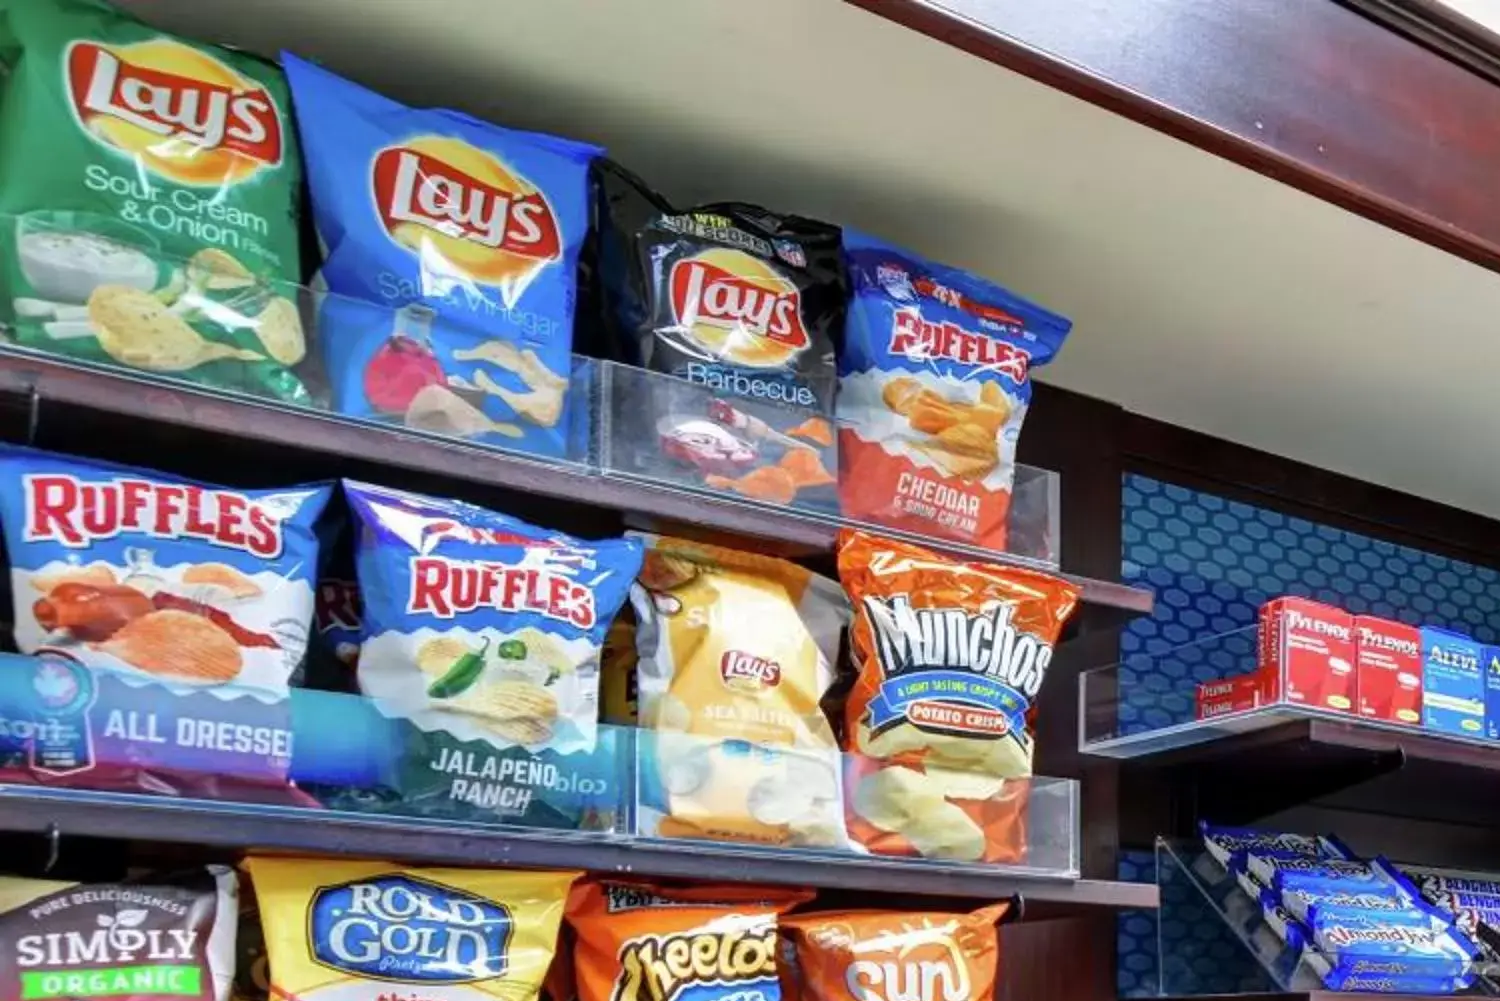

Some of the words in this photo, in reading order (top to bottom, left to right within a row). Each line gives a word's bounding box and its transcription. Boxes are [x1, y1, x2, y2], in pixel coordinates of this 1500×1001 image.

[84, 47, 268, 151] Lay's
[84, 164, 163, 202] Sour
[172, 190, 268, 236] Cream
[390, 153, 545, 249] Lay's
[377, 270, 427, 300] Sal
[683, 265, 796, 341] Lay's
[890, 310, 1030, 385] RUFFLES
[686, 361, 815, 407] Barbecue
[897, 471, 981, 517] CHEDDAR
[30, 476, 283, 557] RUFFLES
[411, 558, 595, 628] RUFFLES
[864, 597, 1053, 697] Munchos
[1286, 609, 1353, 641] TYLENOL
[1359, 627, 1420, 659] TYLENOL
[725, 651, 780, 683] Lay's
[104, 708, 167, 743] ALL
[912, 705, 961, 725] POTATO
[431, 747, 556, 788] JALAPEÑO
[449, 779, 532, 811] RANCH
[29, 897, 72, 920] PURE
[72, 889, 189, 916] DELICIOUSNESS
[346, 883, 486, 927] ROLD
[15, 928, 198, 967] SIMPLY
[329, 917, 492, 975] GOLD
[41, 968, 185, 994] ORGANIC
